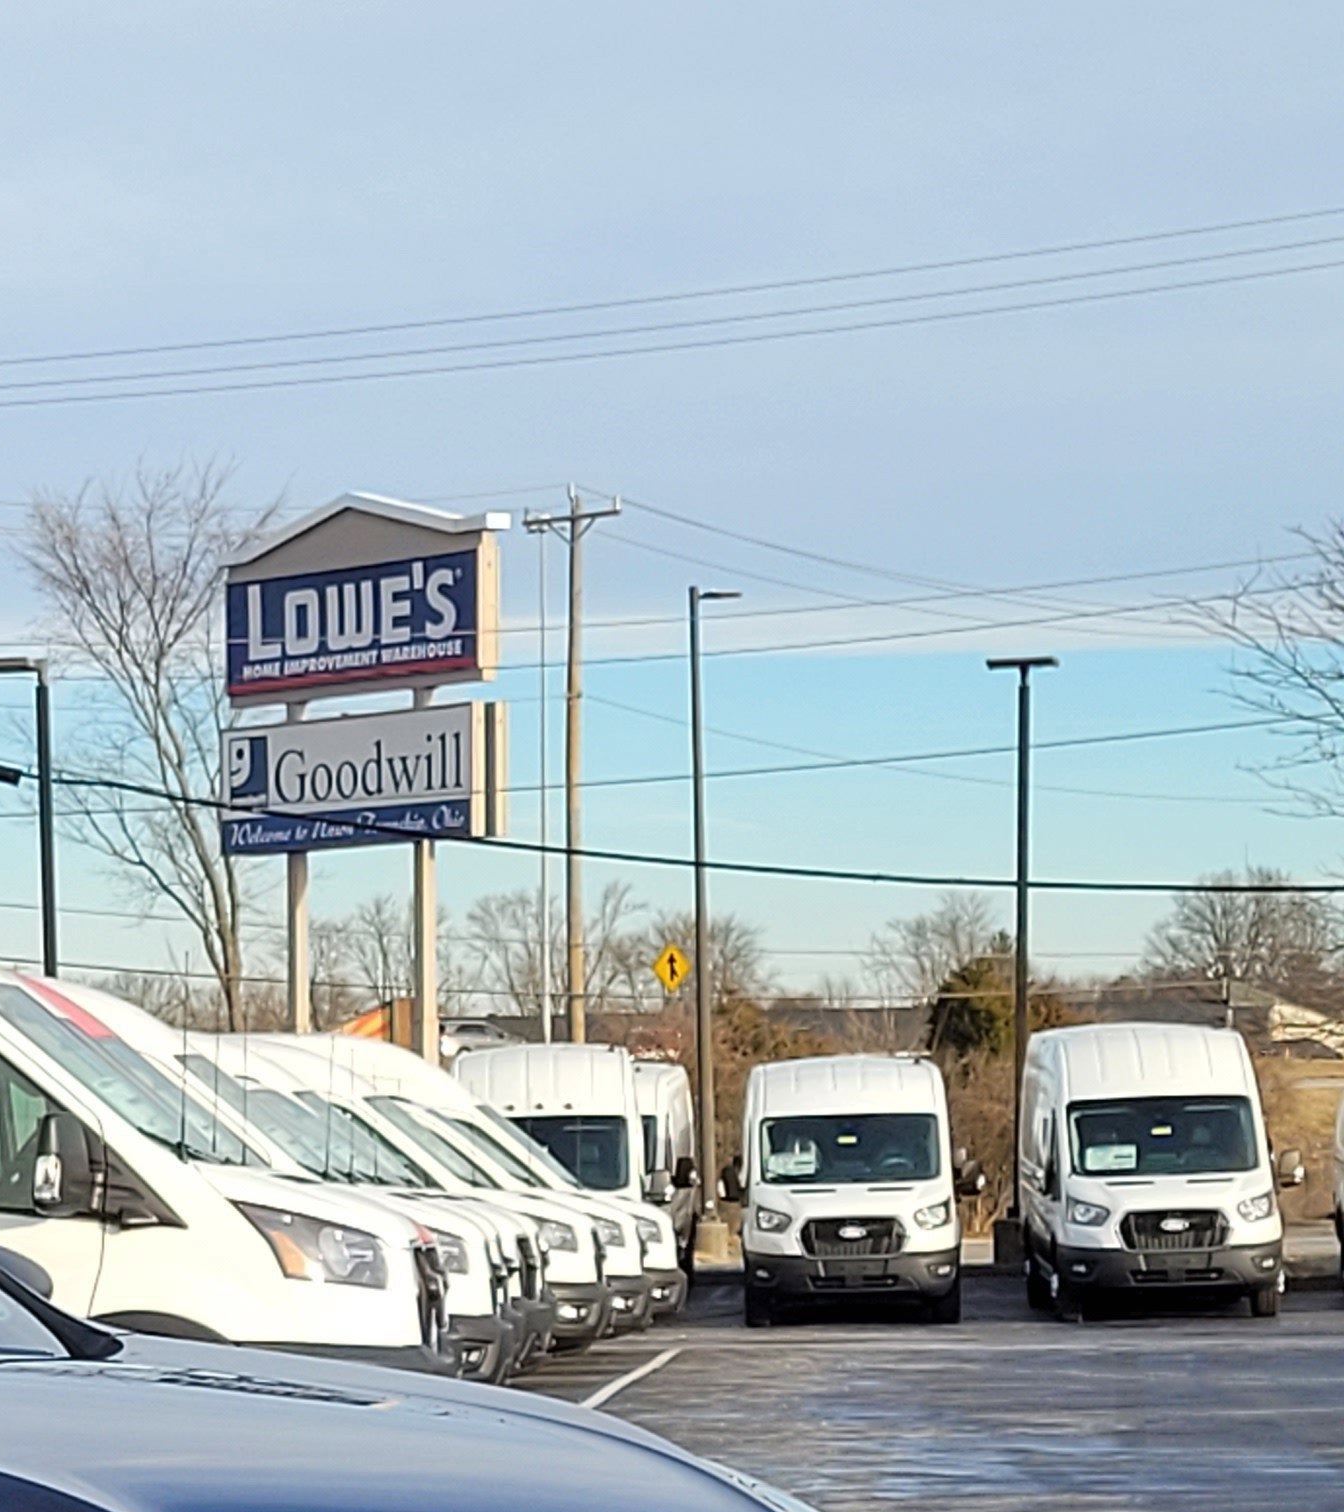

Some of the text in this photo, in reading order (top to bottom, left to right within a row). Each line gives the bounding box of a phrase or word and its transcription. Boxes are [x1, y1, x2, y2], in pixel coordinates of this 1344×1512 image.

[245, 561, 459, 661] LOWE'S
[242, 639, 463, 680] HOME IMPROVEMENT WAREHOUSE
[274, 731, 464, 803] Goodwill
